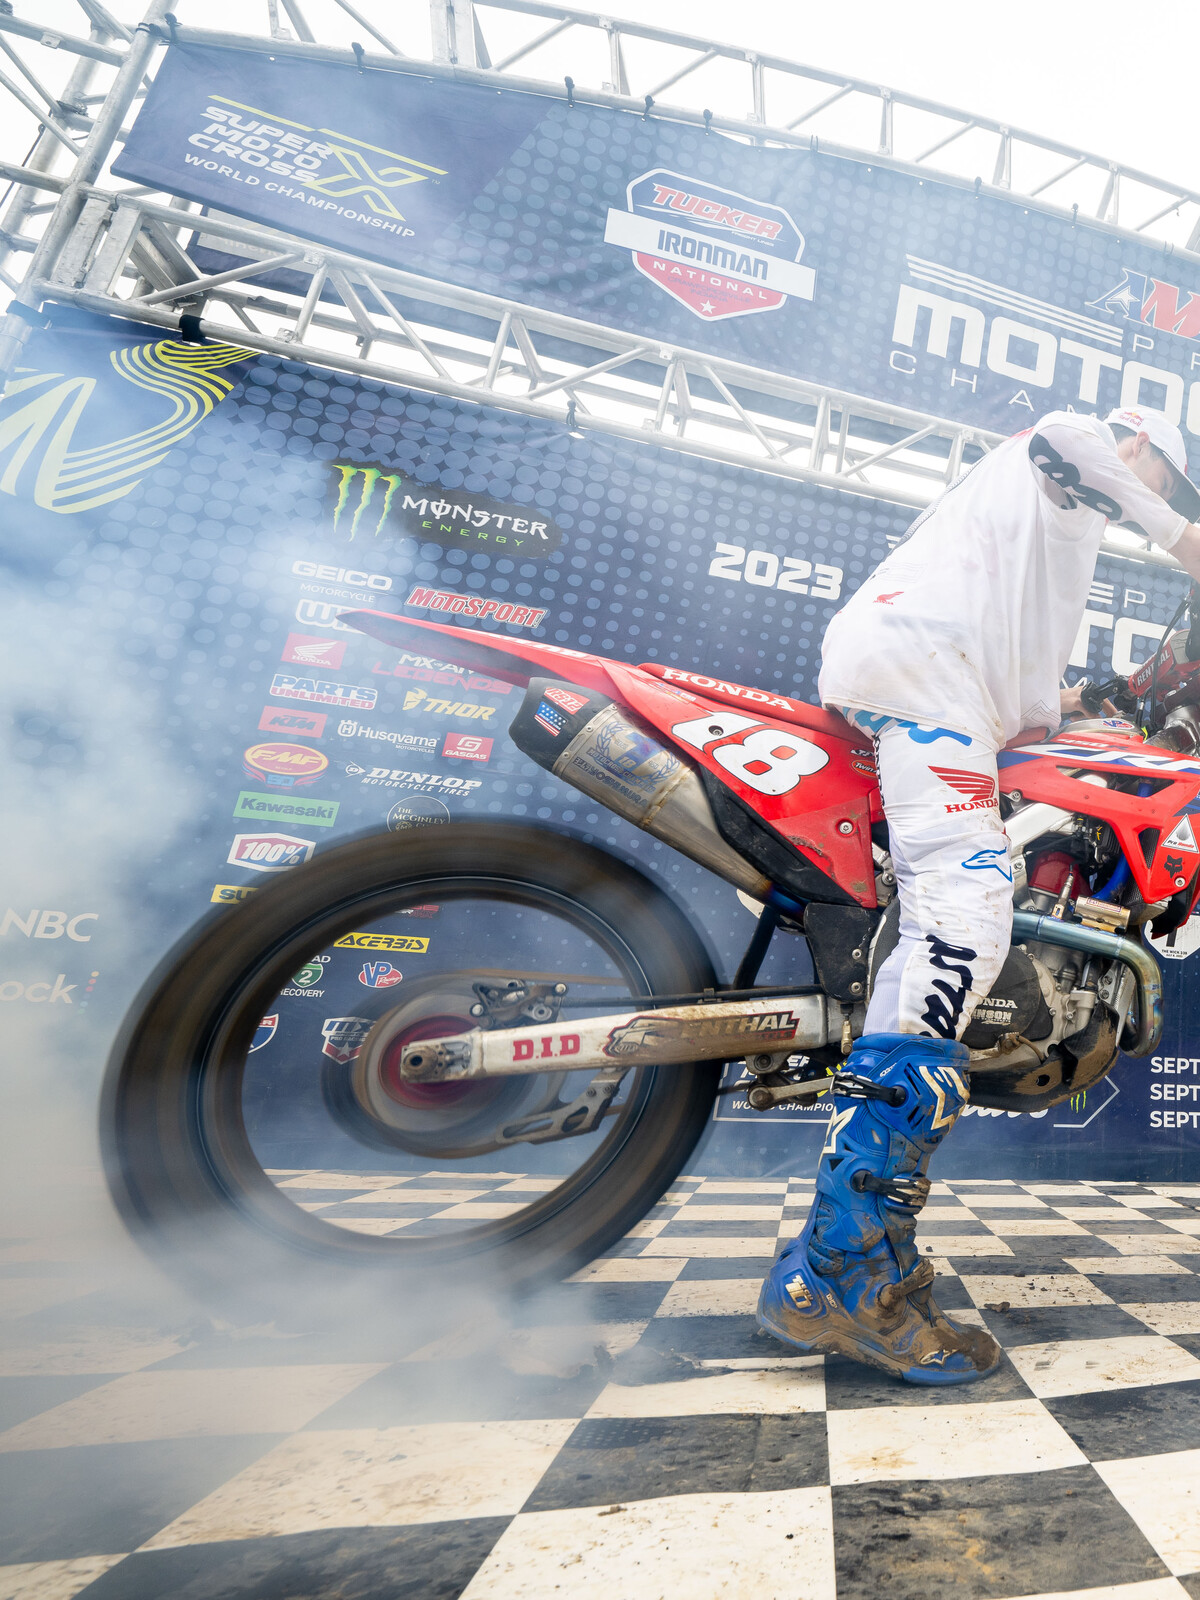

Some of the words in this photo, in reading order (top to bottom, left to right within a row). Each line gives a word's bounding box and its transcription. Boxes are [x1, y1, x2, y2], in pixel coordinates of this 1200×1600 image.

[200, 106, 334, 161] SUPER
[203, 122, 322, 171] MOTO
[188, 133, 320, 184] CROSS
[184, 153, 261, 187] WORLD
[264, 181, 416, 239] CHAMPIONSHIP
[653, 183, 783, 241] TUCKER
[657, 229, 768, 280] IRONMAN
[653, 260, 768, 300] NATIONAL
[421, 520, 524, 547] ENERGY
[291, 560, 393, 592] GEICO
[708, 541, 844, 600] 2023
[300, 582, 376, 604] MOTORCYCLE
[291, 654, 332, 666] HONDA
[398, 654, 437, 669] MX
[1137, 650, 1171, 687] RENTAL
[274, 674, 378, 701] PARTS
[371, 661, 514, 695] LEGENDS
[271, 686, 375, 710] UNLIMITED
[661, 668, 795, 712] HONDA
[423, 698, 497, 721] THOR
[269, 714, 316, 731] KTM
[357, 725, 438, 748] Husqvarna
[250, 749, 322, 766] FMF
[445, 750, 487, 760] GASGAS
[619, 754, 637, 770] 18
[671, 711, 830, 797] 18
[360, 777, 437, 793] MOTORCYCLE
[438, 787, 472, 797] TIRES
[367, 767, 482, 790] DUNLOP
[240, 798, 335, 820] Kawasaki
[397, 807, 413, 815] THE
[944, 797, 999, 813] HONDA
[242, 840, 305, 865] 100%
[0, 907, 99, 943] NBC
[337, 934, 424, 950] ACERBIS
[298, 969, 313, 985] 2
[363, 961, 393, 987] VP
[377, 974, 401, 986] Racing
[979, 997, 1018, 1009] NDA
[513, 1033, 581, 1062] D.I.D
[1150, 1057, 1200, 1074] SEPT
[1150, 1084, 1200, 1101] SEPT
[1150, 1112, 1200, 1128] SEPT
